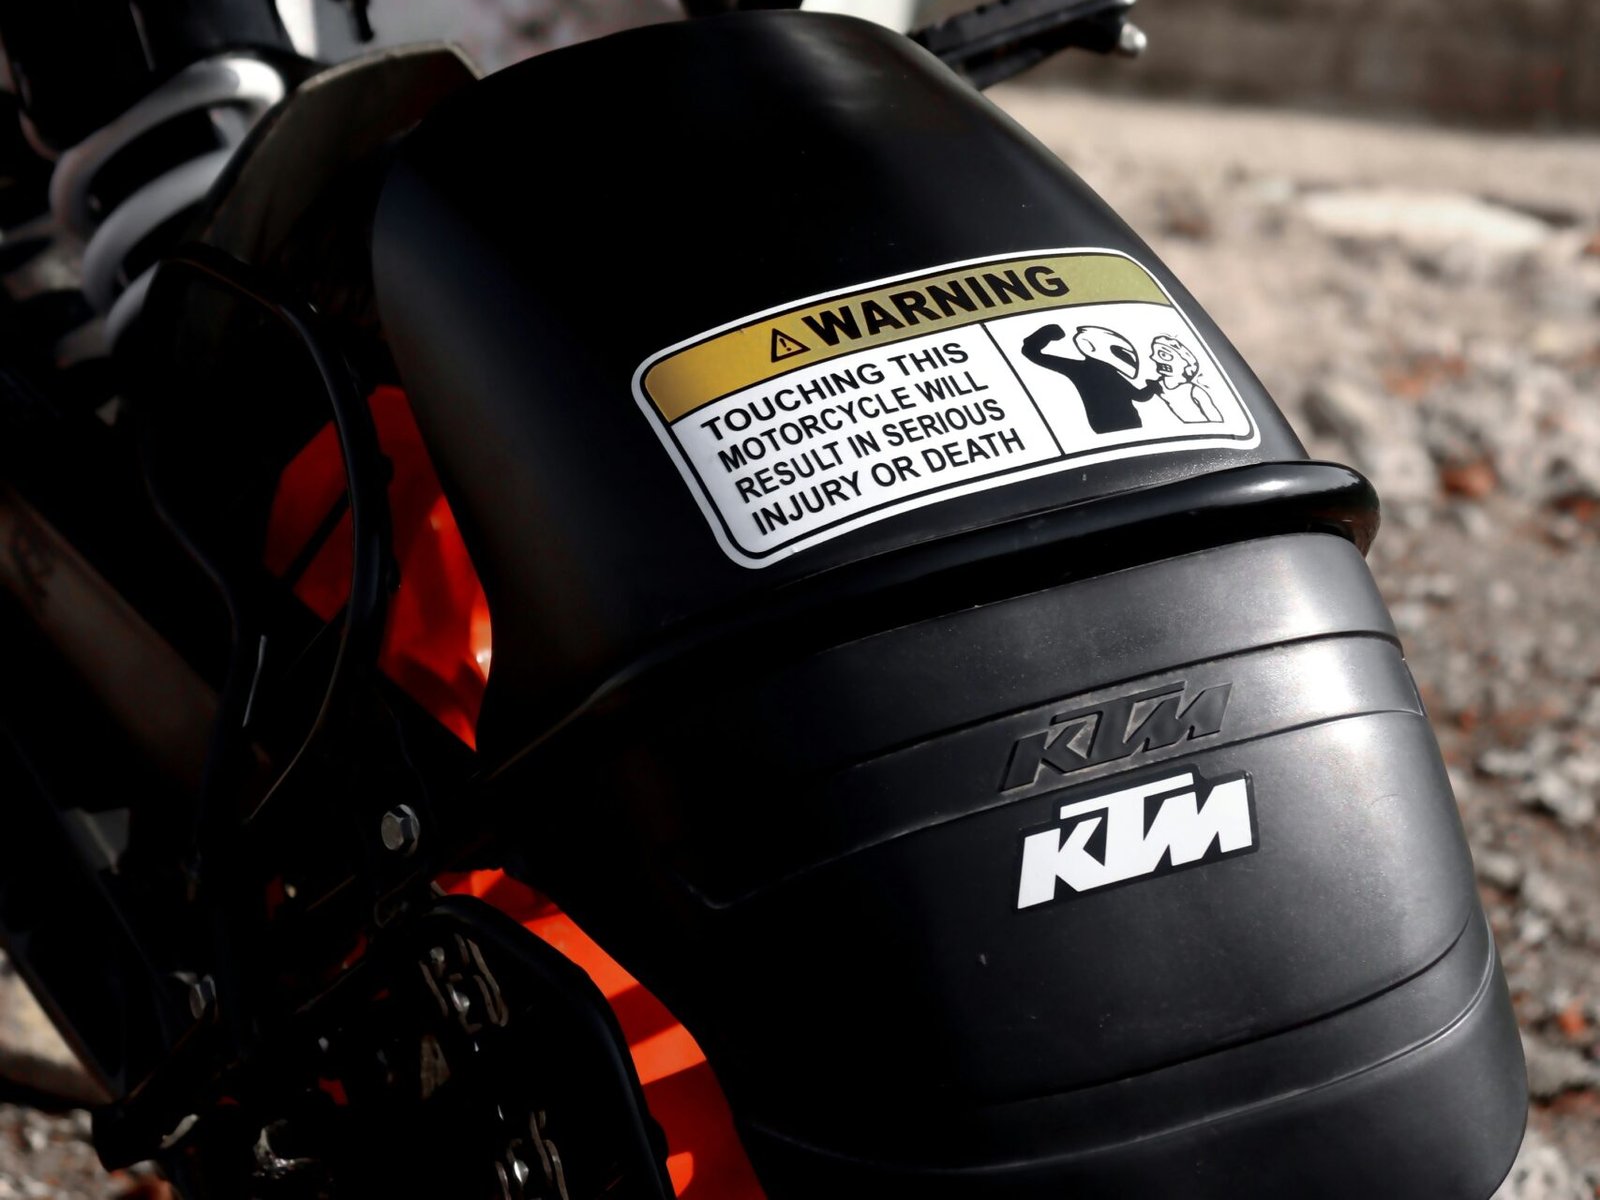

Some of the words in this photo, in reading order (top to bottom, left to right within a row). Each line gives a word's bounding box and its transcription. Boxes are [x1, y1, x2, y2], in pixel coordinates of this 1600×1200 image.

[801, 266, 1070, 346] WARNING
[700, 363, 886, 440] TOUCHING
[887, 342, 969, 376] THIS
[717, 387, 916, 473] MOTORCYCLE
[914, 371, 988, 403] WILL
[735, 441, 843, 504] RESULT
[847, 430, 881, 458] IN
[882, 399, 1005, 447] SERIOUS
[752, 470, 862, 535] INJURY
[871, 455, 921, 488] OR
[921, 428, 1026, 474] DEATH
[1000, 681, 1233, 792] KTM
[1017, 772, 1252, 910] KTM
